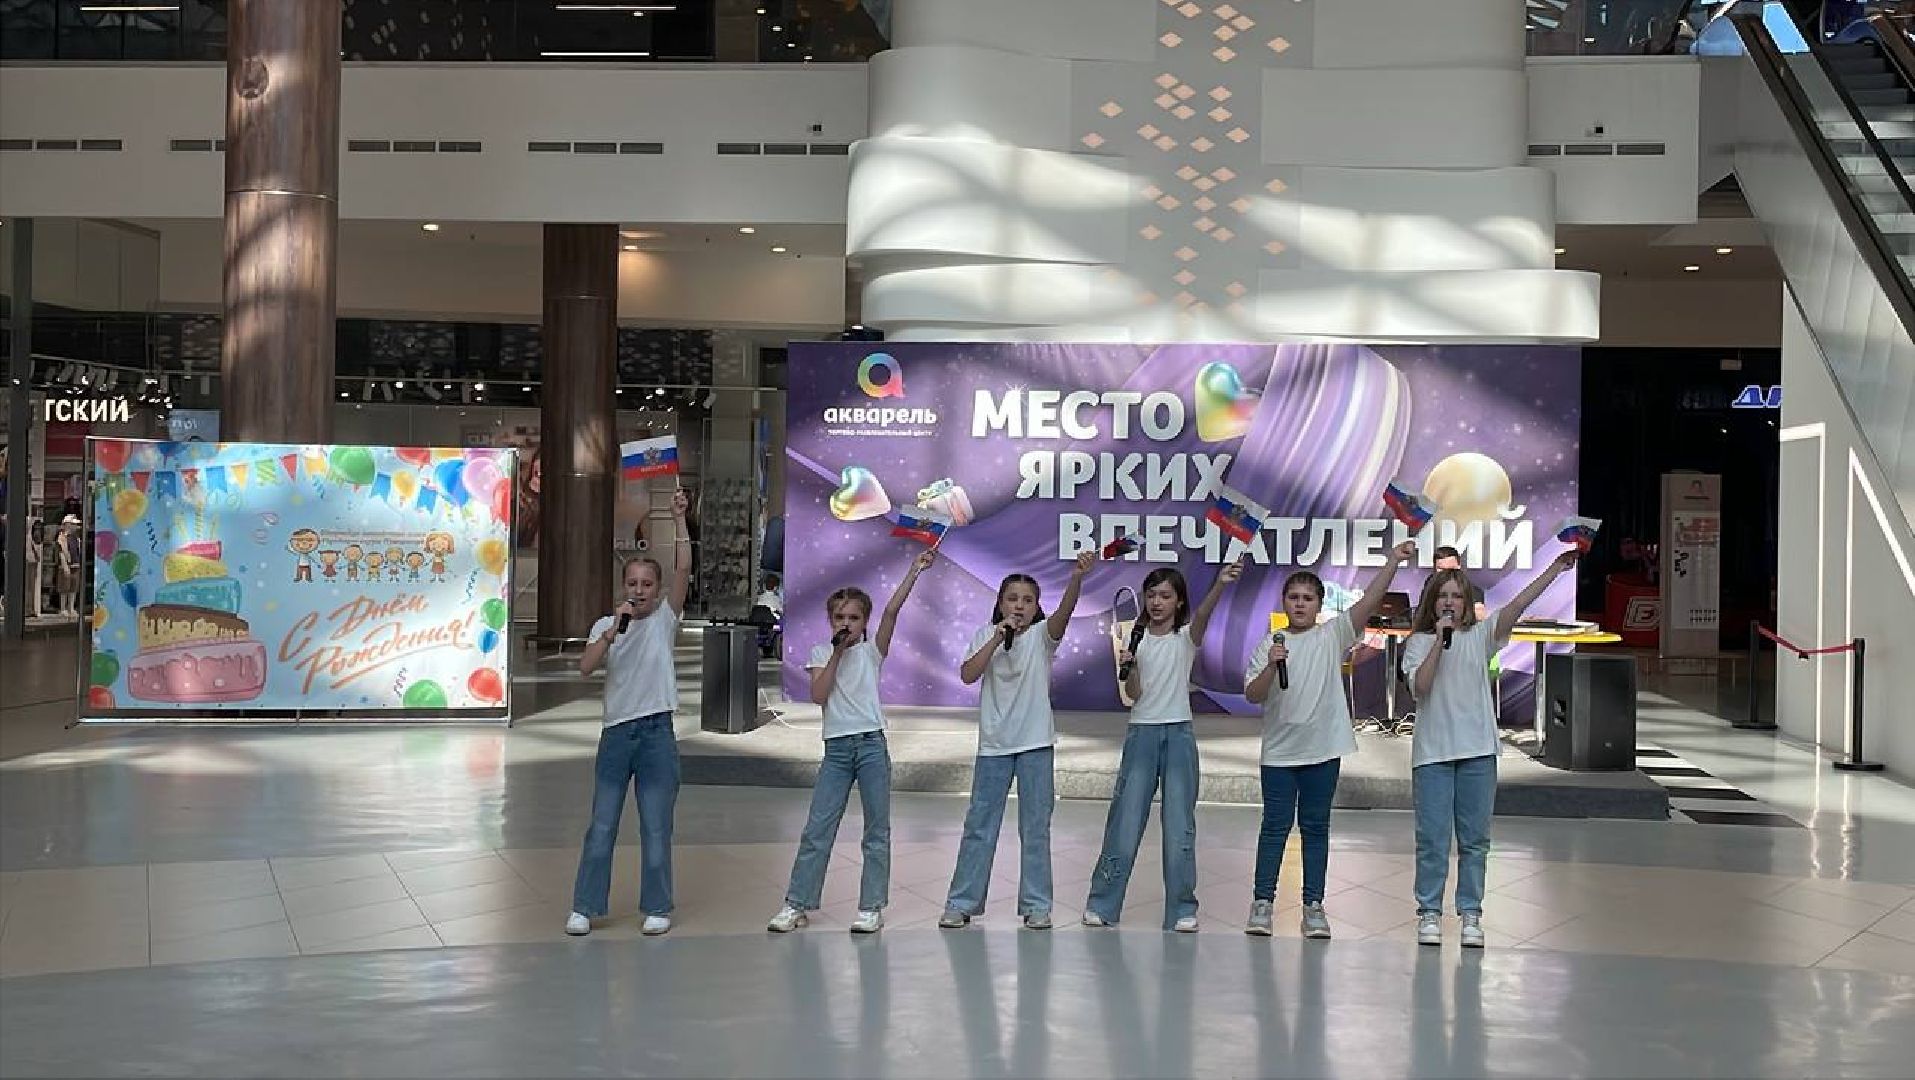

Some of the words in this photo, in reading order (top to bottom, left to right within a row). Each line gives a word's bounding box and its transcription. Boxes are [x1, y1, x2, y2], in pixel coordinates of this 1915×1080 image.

[823, 407, 937, 427] акварель
[971, 389, 1185, 442] МЕСТО
[1016, 450, 1232, 502] ЯРКИХ
[1059, 504, 1534, 569] ВПЕЧАТЛЕНИЙ
[278, 610, 319, 663] С
